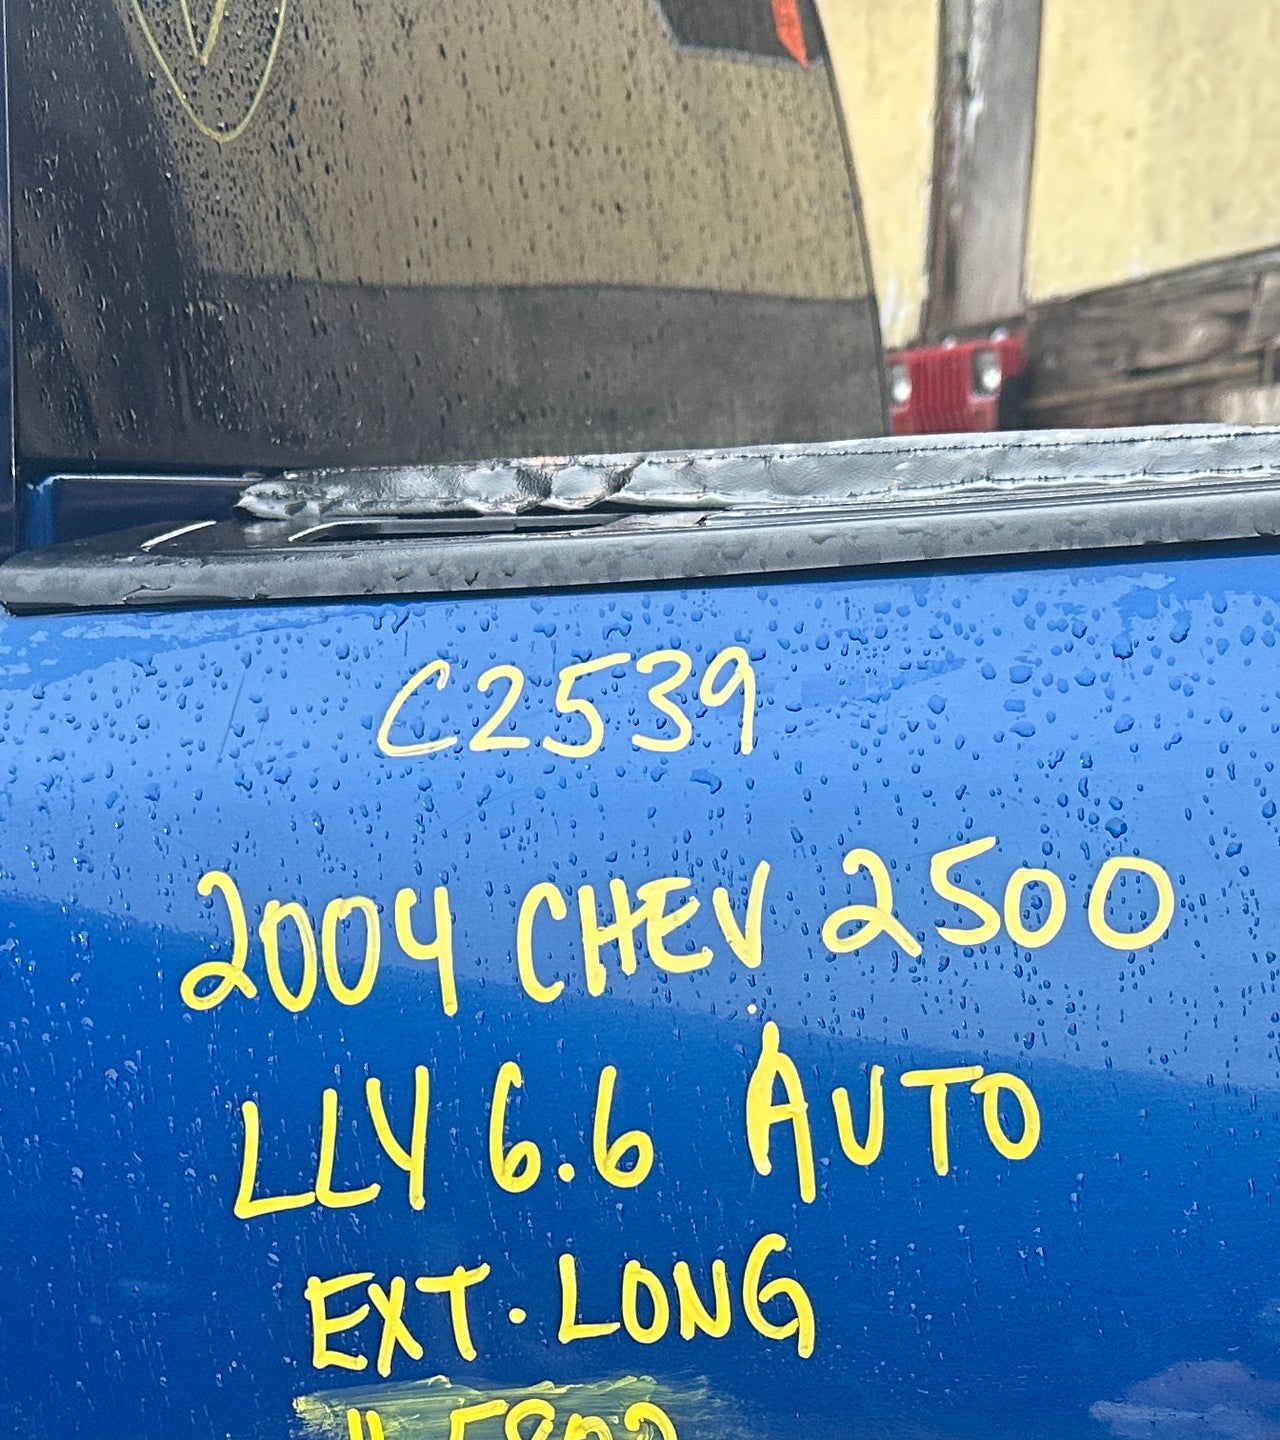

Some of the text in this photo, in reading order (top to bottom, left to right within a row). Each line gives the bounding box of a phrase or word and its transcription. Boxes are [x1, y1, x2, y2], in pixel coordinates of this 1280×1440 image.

[376, 647, 756, 757] C2539
[179, 836, 1175, 1016] 2004 CHEV 2500
[233, 1020, 1041, 1219] LLY 6.6 AUTO
[557, 1233, 817, 1359] LONG
